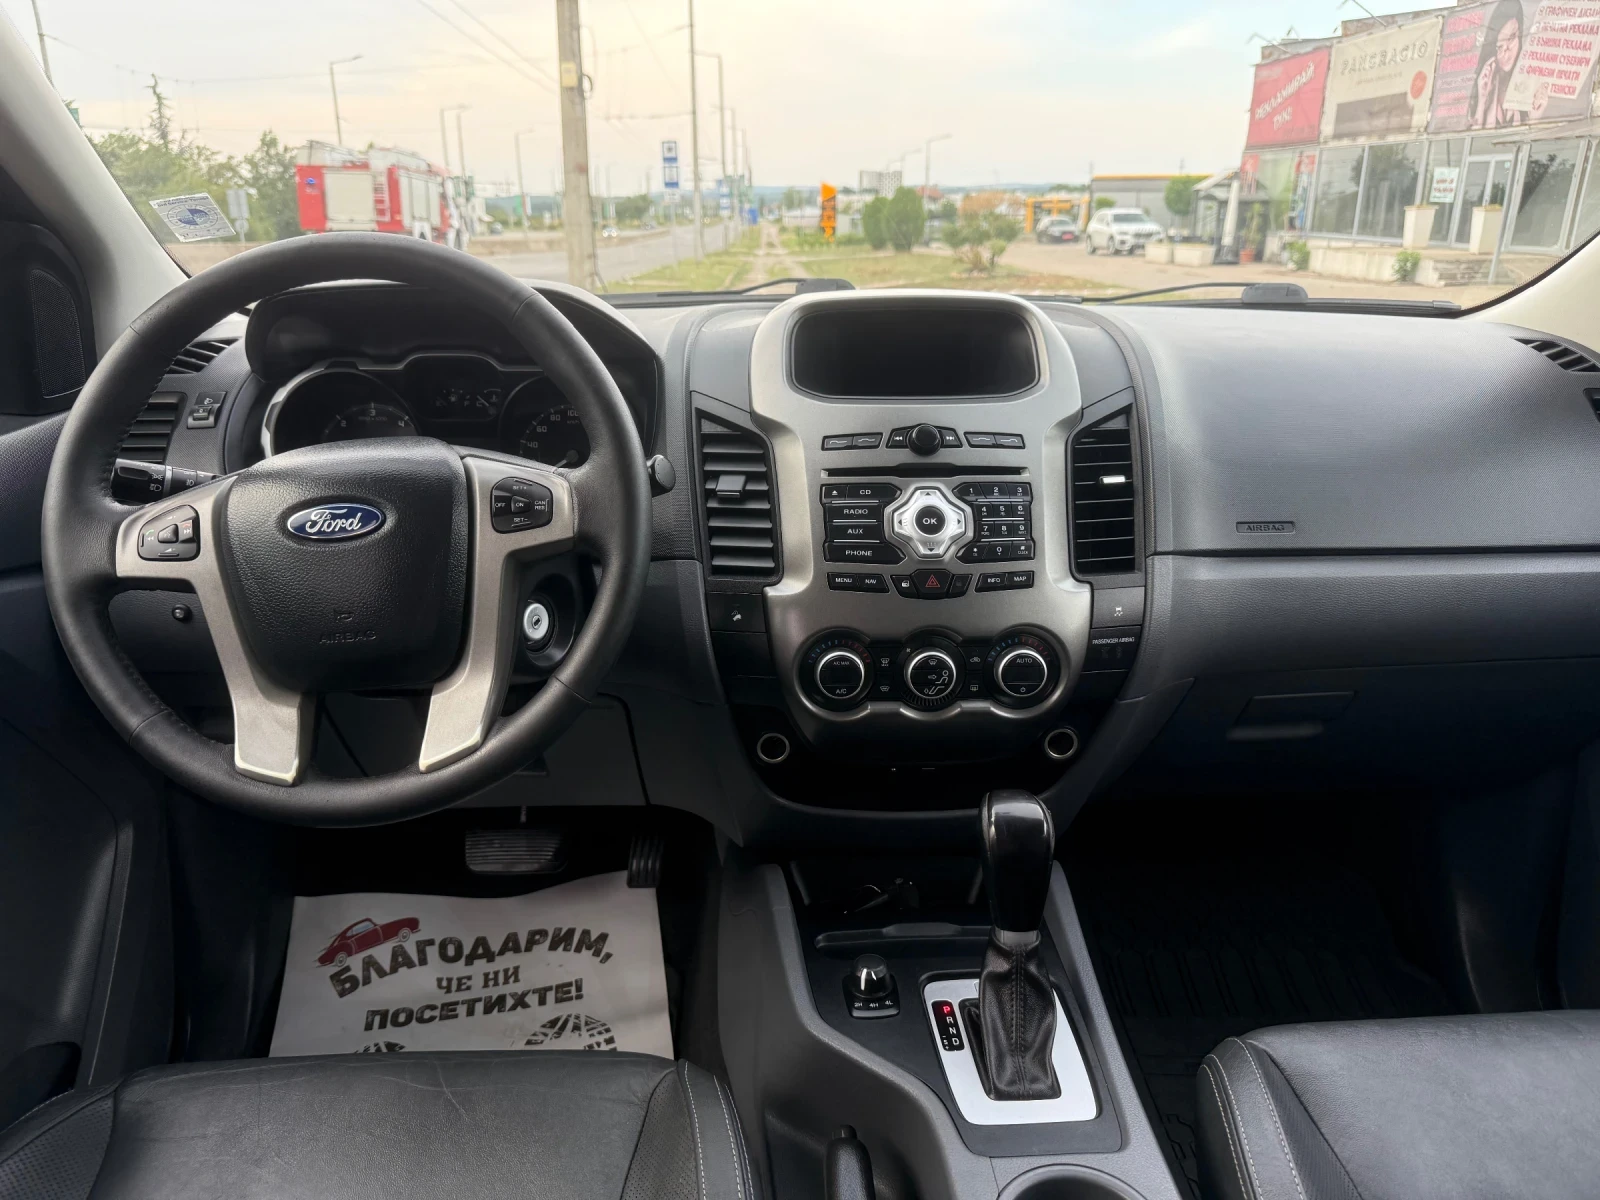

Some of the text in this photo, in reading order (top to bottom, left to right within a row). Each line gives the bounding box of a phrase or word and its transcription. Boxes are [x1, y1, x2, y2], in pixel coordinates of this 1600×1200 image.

[1562, 39, 1592, 51] РЕКЛАМА
[305, 508, 362, 534] Ford
[319, 630, 377, 644] AIRBAG
[329, 926, 614, 998] БЛАГОДАРИМ,
[436, 966, 522, 994] ЧЕ НИ
[364, 978, 584, 1031] ПОСЕТИХТЕ!
